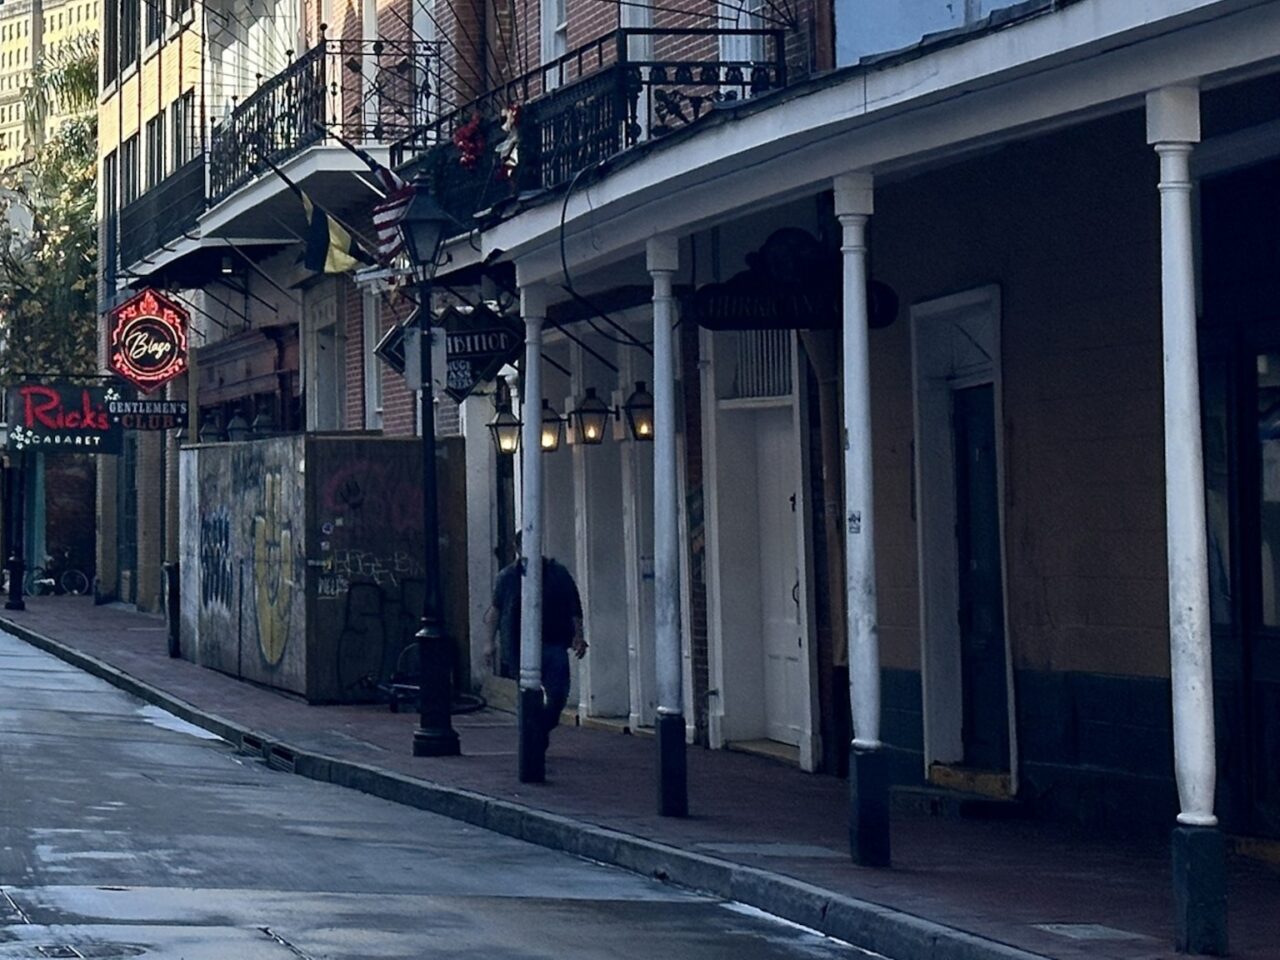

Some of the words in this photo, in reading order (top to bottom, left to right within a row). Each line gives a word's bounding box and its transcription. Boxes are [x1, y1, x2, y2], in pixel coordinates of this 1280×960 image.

[447, 333, 509, 354] IBITION
[19, 385, 110, 430] Rick's
[109, 401, 187, 414] GENTLEMEN'S
[122, 414, 175, 429] CLUB
[32, 435, 100, 446] CABARET
